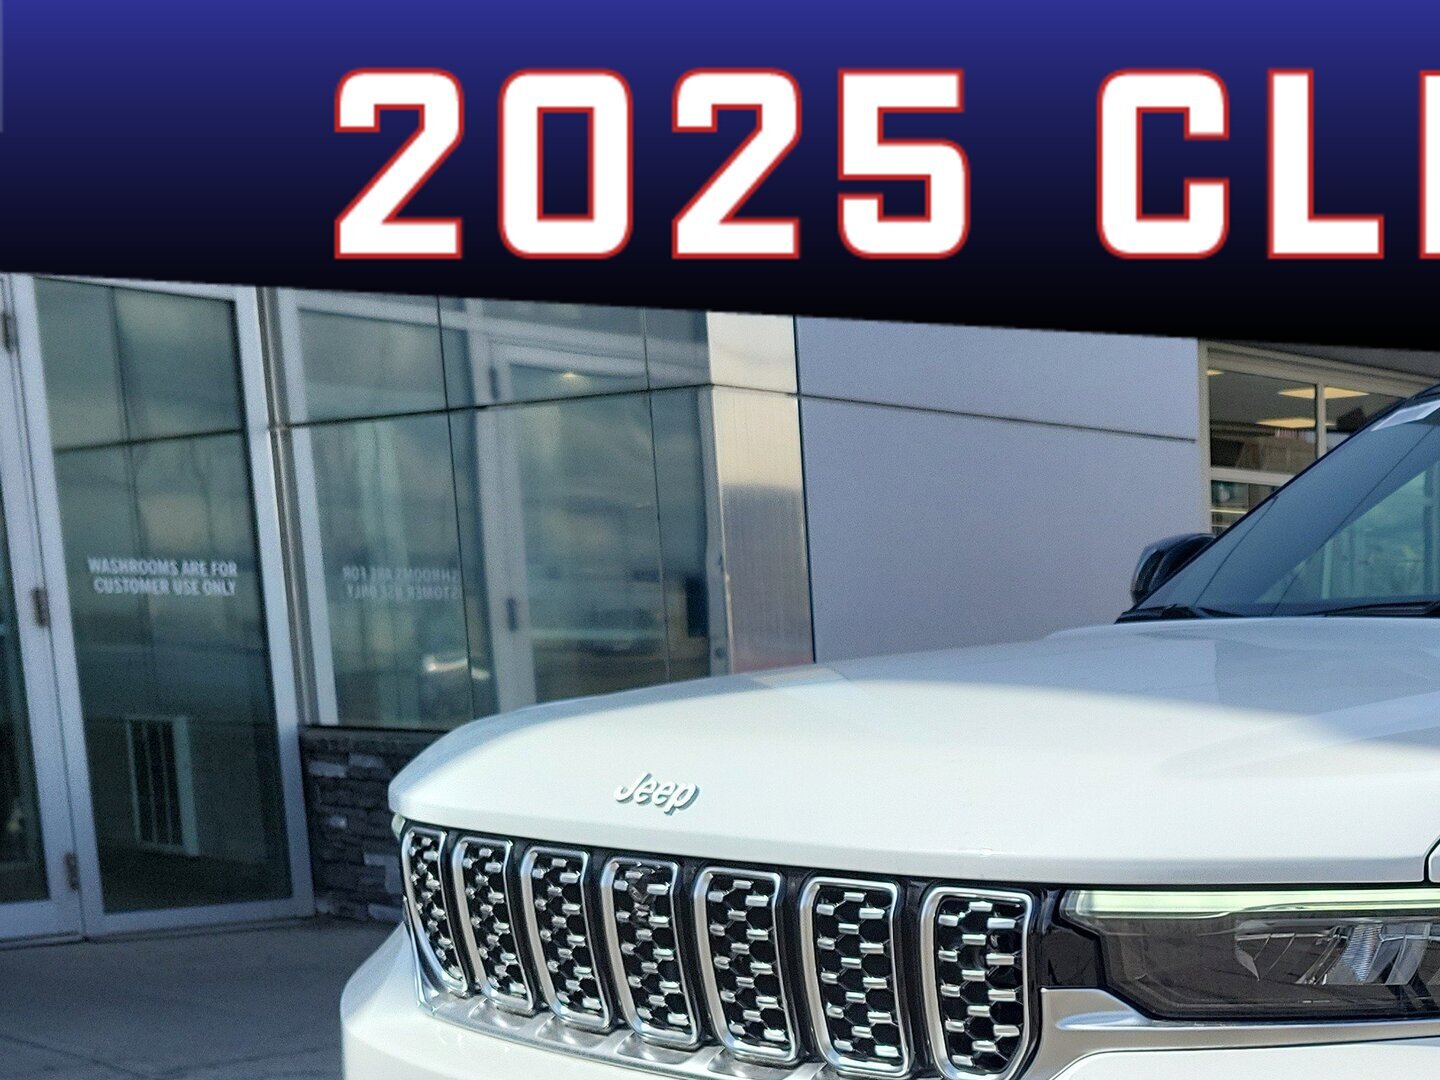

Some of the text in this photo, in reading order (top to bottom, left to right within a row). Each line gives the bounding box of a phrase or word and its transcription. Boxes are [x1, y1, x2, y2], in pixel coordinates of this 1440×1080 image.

[88, 556, 238, 577] WASHROOMS ARE FOR
[93, 576, 236, 596] CUSTOMER USE ONLY
[614, 772, 700, 816] Jeep
